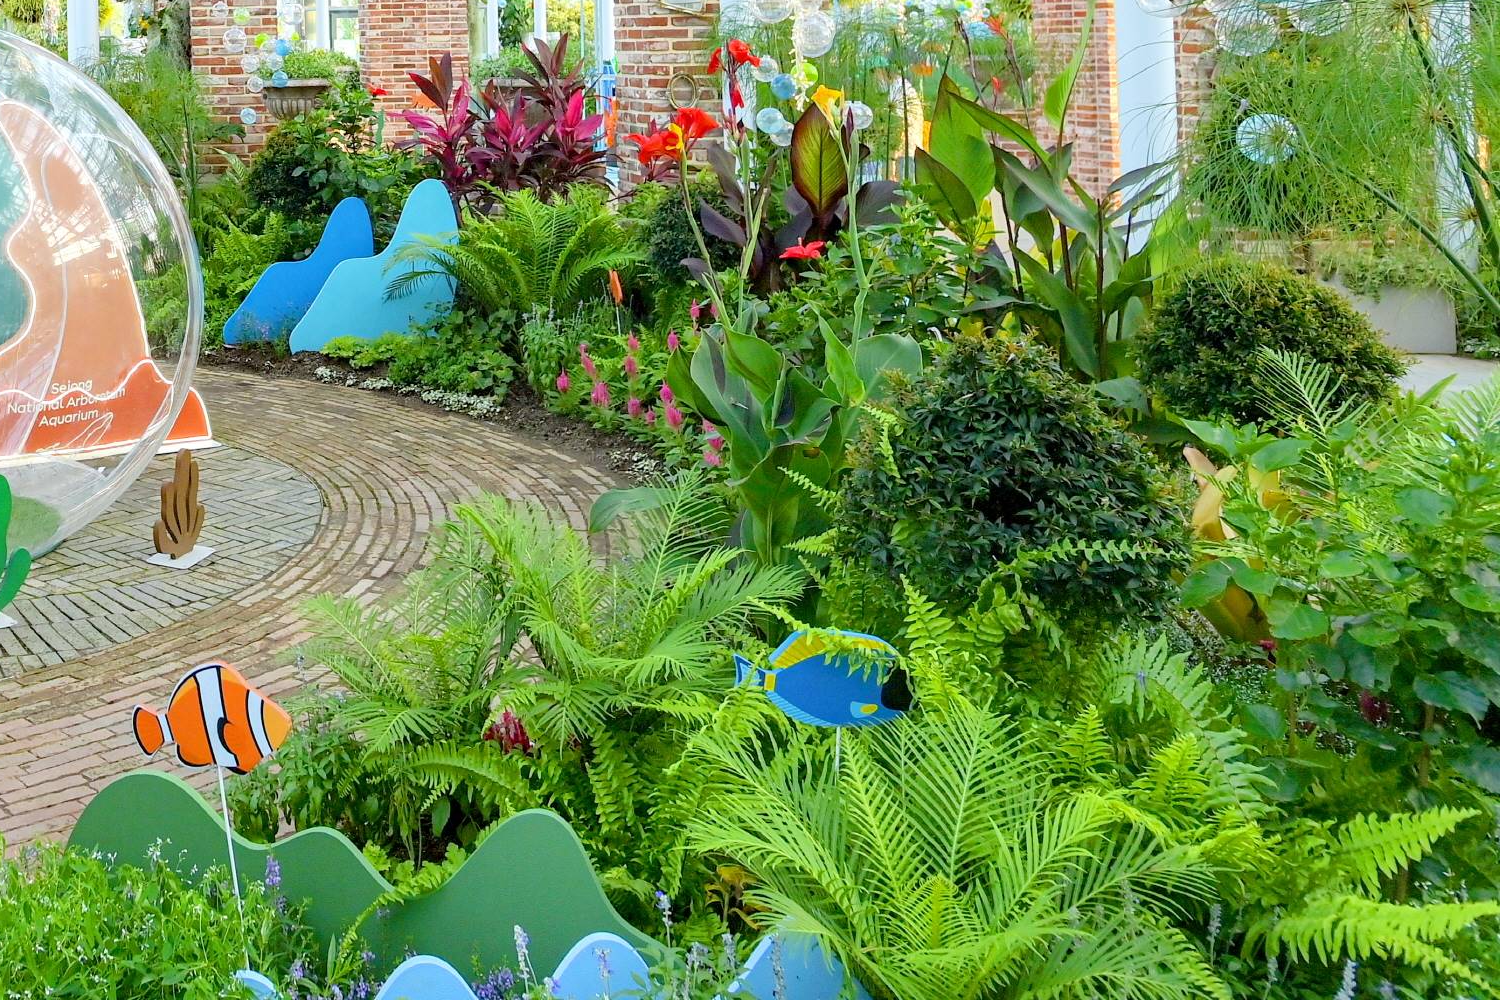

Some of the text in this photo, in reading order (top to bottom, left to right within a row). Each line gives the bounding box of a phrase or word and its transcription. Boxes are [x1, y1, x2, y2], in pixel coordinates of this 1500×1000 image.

[51, 379, 92, 395] Sejong
[7, 401, 64, 414] National
[38, 410, 99, 427] Aquarium
